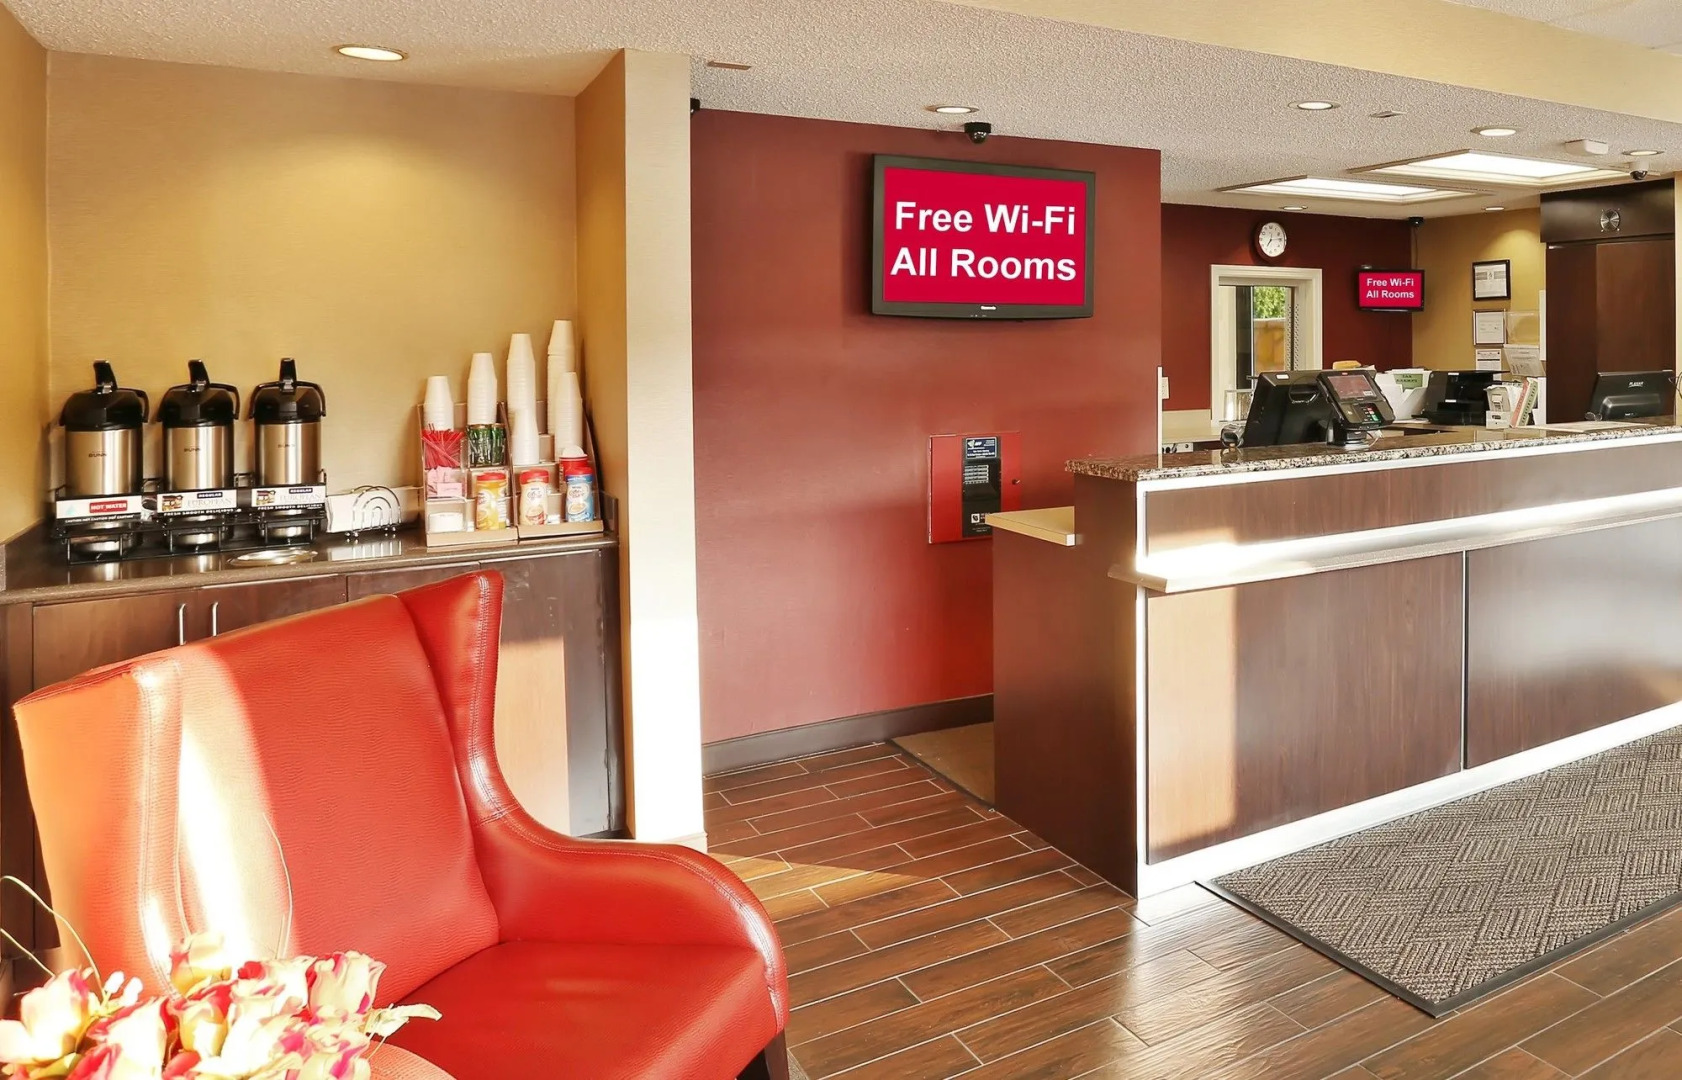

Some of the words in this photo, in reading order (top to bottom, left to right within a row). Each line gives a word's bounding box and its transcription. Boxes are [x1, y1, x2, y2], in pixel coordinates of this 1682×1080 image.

[895, 201, 973, 232] Free
[984, 203, 1076, 235] Wi-Fi
[890, 247, 937, 277] All
[951, 249, 1077, 281] Rooms
[1366, 278, 1387, 286] Free
[1390, 278, 1414, 286] Wi-Fi
[1366, 290, 1379, 298] All
[1381, 290, 1415, 299] Rooms
[105, 502, 127, 510] WATER
